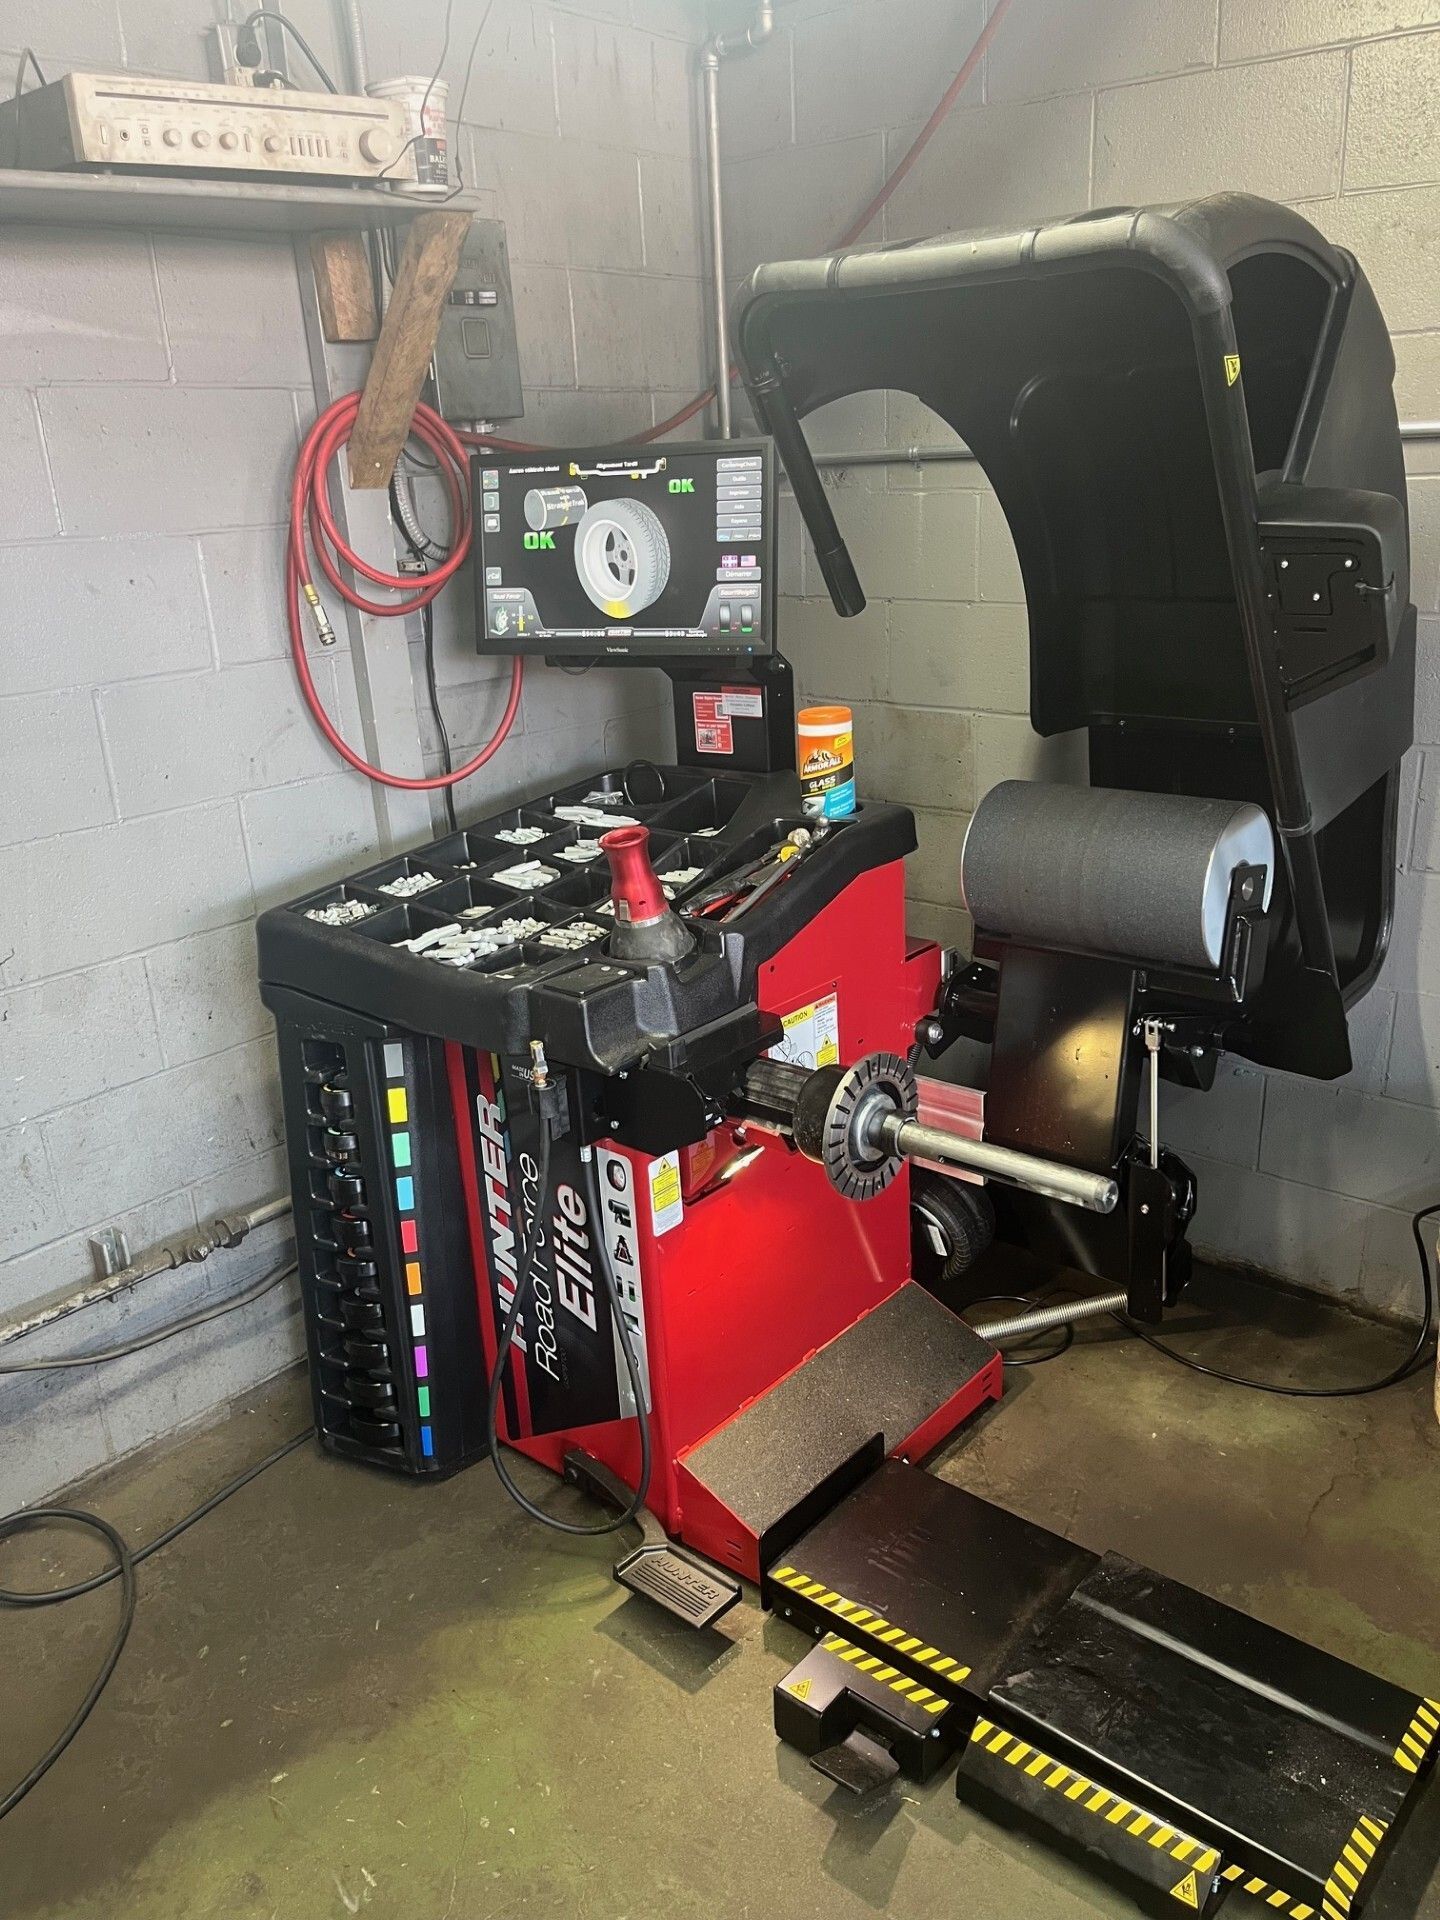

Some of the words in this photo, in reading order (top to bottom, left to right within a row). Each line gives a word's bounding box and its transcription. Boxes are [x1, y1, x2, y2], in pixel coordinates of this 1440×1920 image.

[669, 478, 695, 493] OK
[523, 531, 556, 549] OK
[809, 775, 836, 789] GLASS
[782, 1010, 808, 1027] CAUTION
[552, 1183, 598, 1333] Elite
[528, 1270, 560, 1382] Road
[651, 1556, 720, 1600] HUNTER
